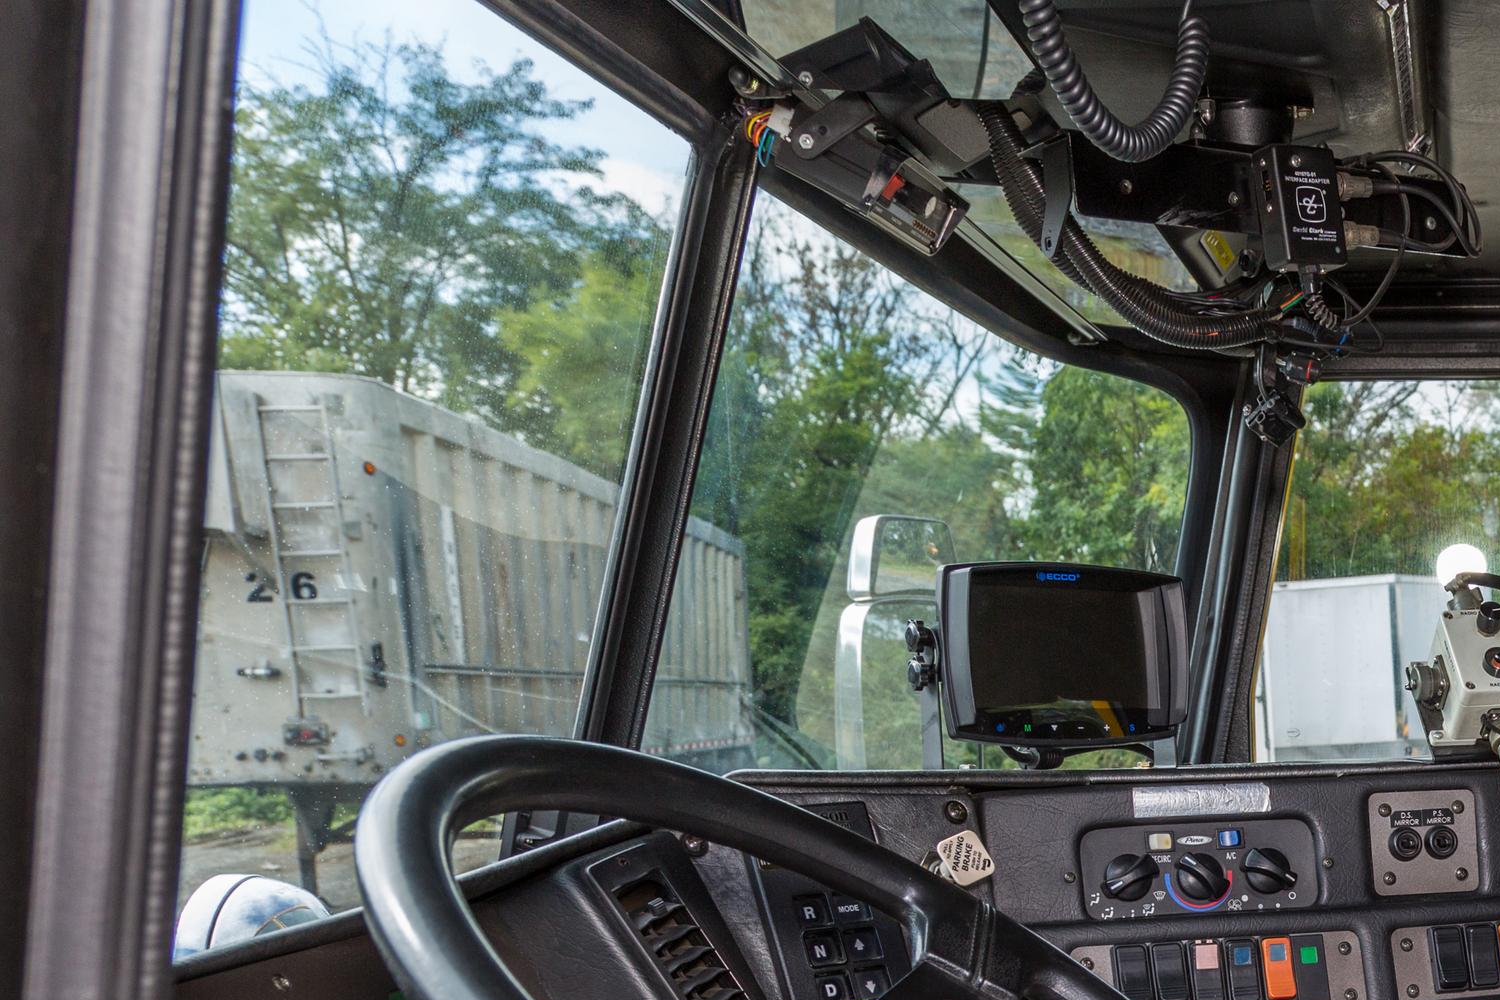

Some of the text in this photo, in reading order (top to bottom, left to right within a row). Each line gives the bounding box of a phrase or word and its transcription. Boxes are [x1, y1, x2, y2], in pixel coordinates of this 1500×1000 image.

[1308, 226, 1324, 234] Clark
[1046, 572, 1077, 581] ECCO
[1024, 724, 1032, 732] M
[1129, 723, 1136, 732] S
[1394, 818, 1420, 826] MIRROR
[1426, 816, 1452, 824] MIRROR
[952, 836, 965, 872] PARKING
[961, 843, 973, 872] BRAKE
[1226, 852, 1237, 860] A/C
[837, 903, 860, 913] MODE
[803, 906, 817, 921] R
[814, 944, 827, 960] N
[825, 983, 838, 998] D
